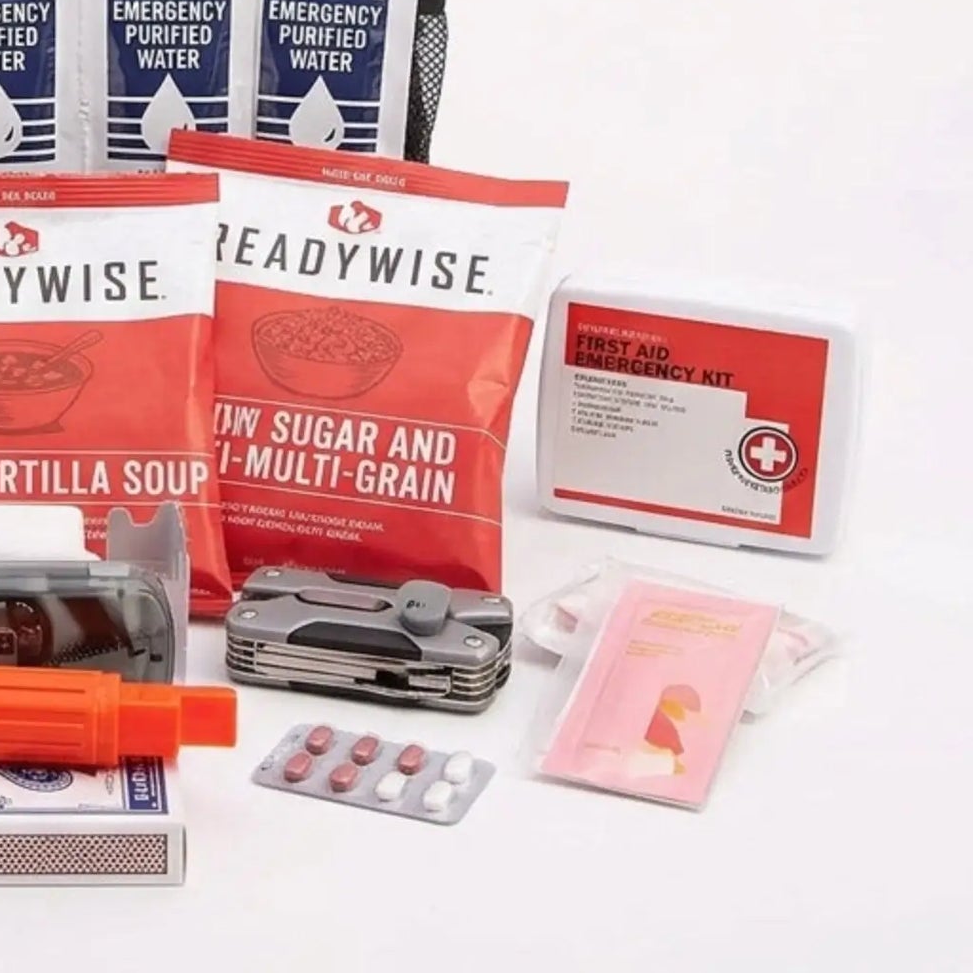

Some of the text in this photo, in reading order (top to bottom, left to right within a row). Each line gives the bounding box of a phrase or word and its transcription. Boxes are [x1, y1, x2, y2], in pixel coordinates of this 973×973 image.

[112, 0, 227, 22] EMERGENCY
[124, 23, 212, 45] PURIFIED
[278, 23, 367, 49] PURIFIED
[136, 47, 200, 69] WATER
[289, 47, 353, 73] WATER
[575, 333, 670, 362] FIRST AID
[701, 368, 736, 388] KIT
[270, 409, 379, 456] SUGAR
[387, 425, 457, 466] AND
[122, 459, 209, 496] SOUP
